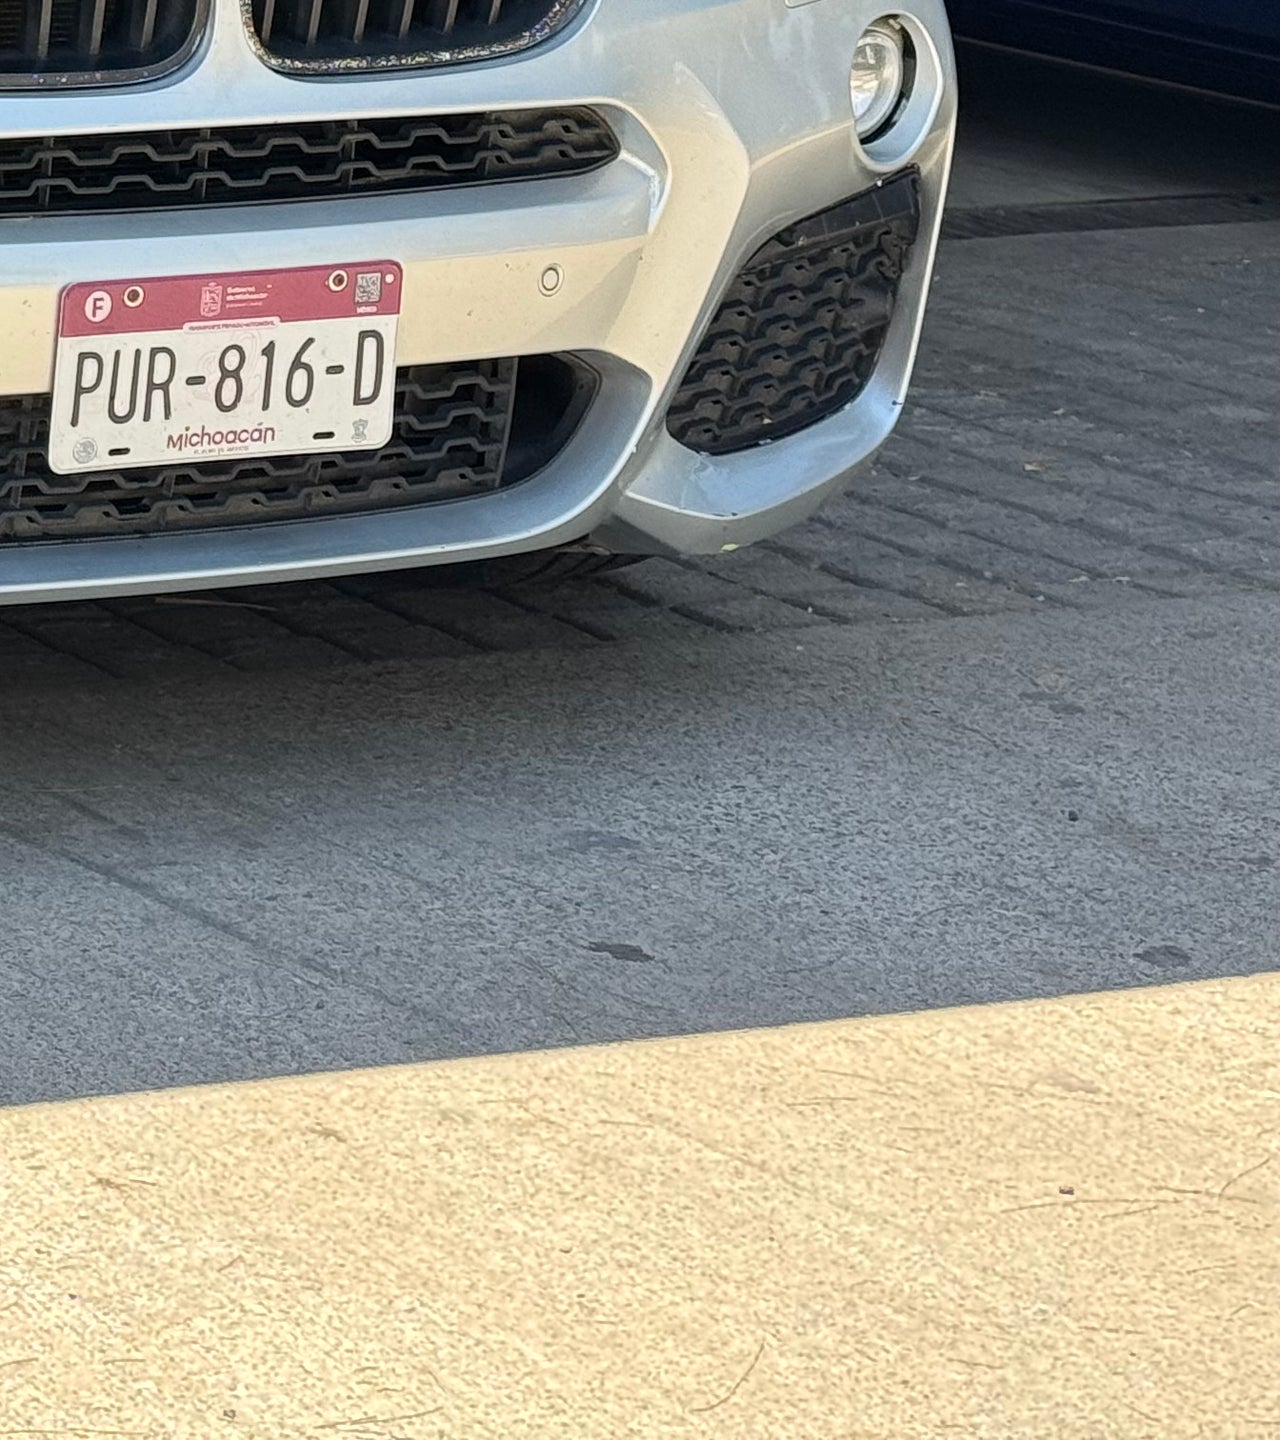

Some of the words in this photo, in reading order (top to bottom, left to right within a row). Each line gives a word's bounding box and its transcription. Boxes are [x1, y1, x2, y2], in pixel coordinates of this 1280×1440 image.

[90, 297, 105, 319] F
[70, 329, 385, 428] PUR-816-D
[166, 422, 276, 451] Michoacán
